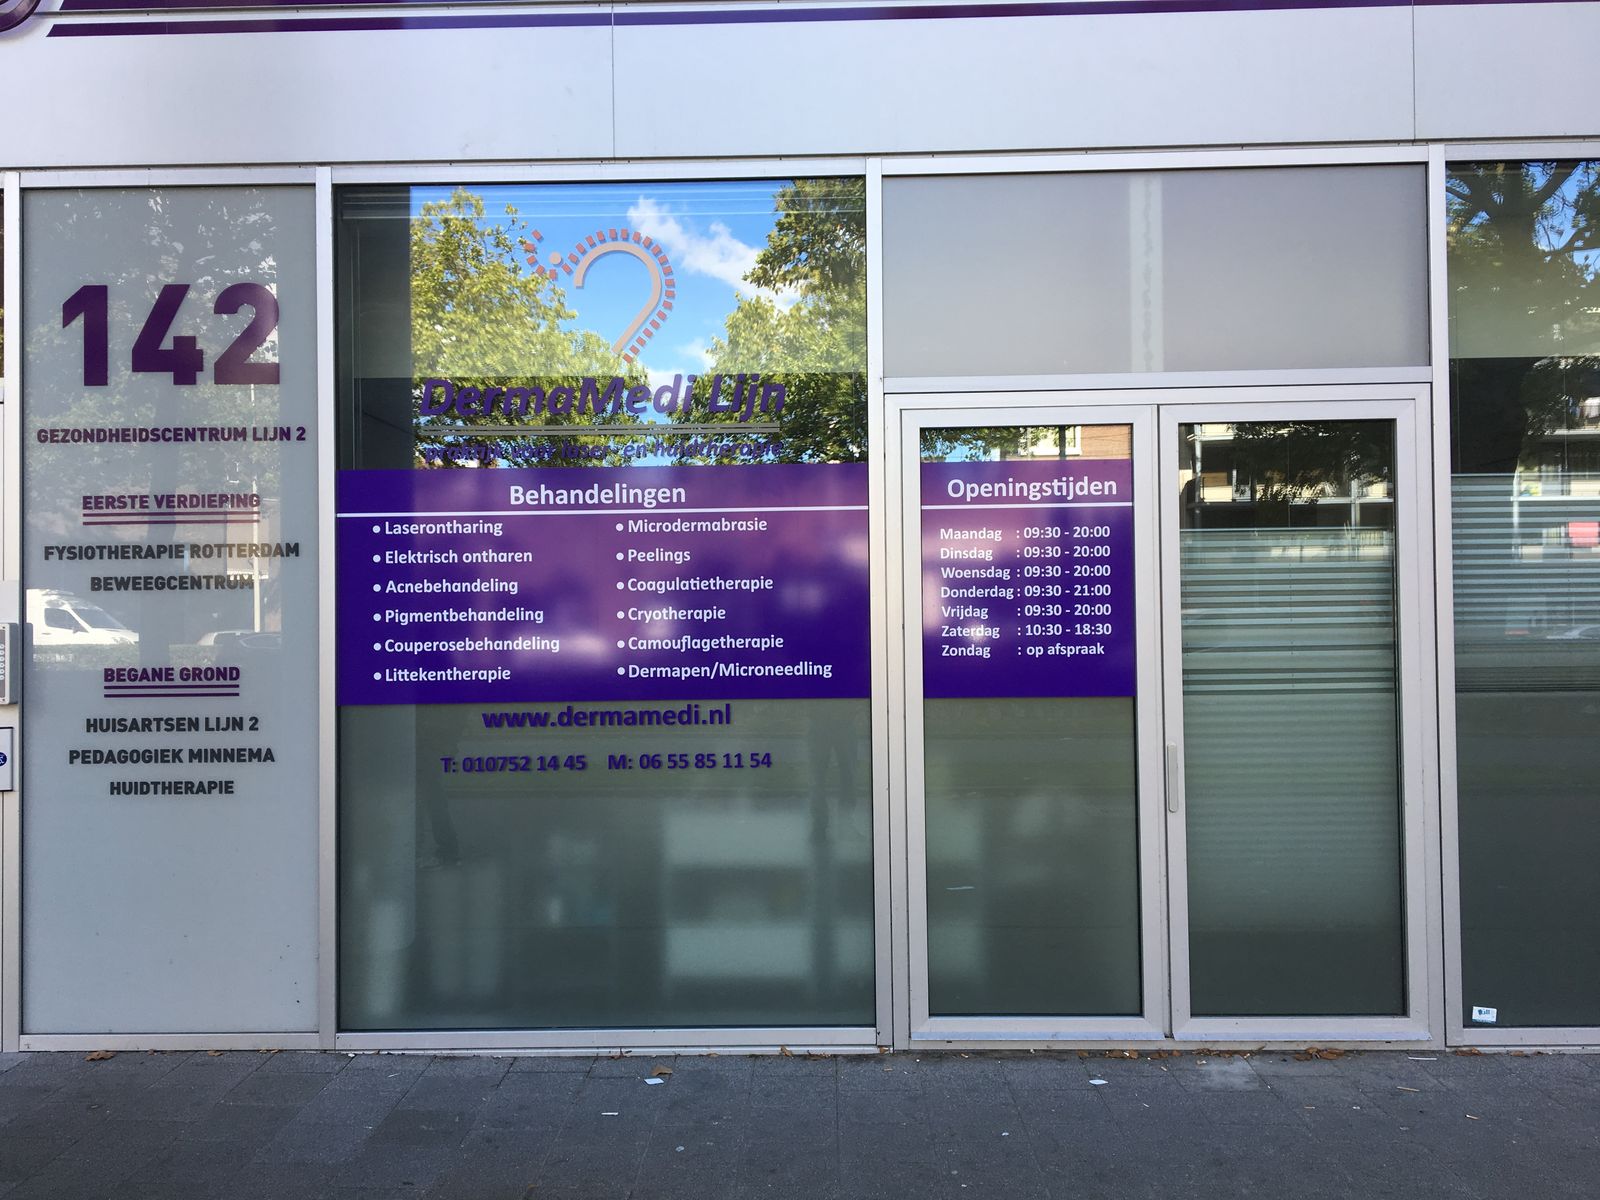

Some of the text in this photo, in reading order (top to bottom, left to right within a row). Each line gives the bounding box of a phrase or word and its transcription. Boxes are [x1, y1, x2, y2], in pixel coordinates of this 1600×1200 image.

[62, 282, 280, 386] 142
[420, 373, 787, 422] DermaMedi Lijn
[37, 426, 306, 444] GEZONDHEIDSCENTRUM LIJN 2
[623, 441, 647, 458] en
[653, 436, 784, 460] huidtherapie
[509, 483, 687, 508] Behandelingen
[947, 476, 1117, 501] Openingstijden
[82, 493, 260, 510] EERSTE VERDIEPING
[385, 519, 503, 537] Laserontharing
[628, 517, 768, 533] Microdermabrasie
[940, 527, 1002, 541] Maandag
[1023, 526, 1061, 539] 09:30
[1073, 526, 1110, 538] 20:00
[44, 542, 300, 560] FYSIOTHERAPIE ROTTERDAM
[385, 548, 533, 564] Elektrisch ontharen
[628, 547, 691, 564] Peelings
[940, 547, 993, 561] Dinsdag
[1023, 546, 1061, 558] 09:30
[1073, 545, 1111, 557] 20:00
[941, 566, 1011, 580] Woensdag
[1024, 565, 1061, 577] 09:30
[1073, 564, 1111, 577] 20:00
[90, 574, 254, 592] BEWEEGCENTRUM
[385, 578, 519, 595] Acnebehandeling
[627, 576, 774, 594] Coagulatietherapie
[940, 586, 1014, 599] Donderdag
[1024, 584, 1062, 597] 09:30
[1074, 584, 1111, 596] 21:00
[385, 607, 544, 625] Pigmentbehandeling
[628, 606, 726, 623] Cryotherapie
[942, 605, 988, 619] Vrijdag
[1024, 604, 1062, 616] 09:30
[1074, 603, 1112, 616] 20:00
[941, 624, 1000, 638] Zaterdag
[1025, 623, 1062, 636] 10:30
[1075, 623, 1112, 635] 18:30
[384, 636, 560, 655] Couperosebehandeling
[628, 634, 784, 652] Camouflagetherapie
[941, 644, 991, 658] Zondag
[1026, 645, 1044, 658] op
[1047, 642, 1105, 657] afspraak
[104, 666, 240, 683] BEGANE GROND
[385, 666, 511, 683] Littekentherapie
[628, 661, 833, 680] Dermapen/Microneedling
[86, 716, 259, 733] HUISARTSEN LIJN 2
[481, 703, 732, 728] www.dermamedi.nl
[69, 747, 275, 765] PEDAGOGIEK MINNEMA
[440, 757, 457, 773] T:
[536, 755, 560, 771] 14
[563, 754, 588, 771] 45
[608, 752, 772, 770] M: 06 55 85 11 54
[110, 780, 234, 796] HUIDTHERAPIE
